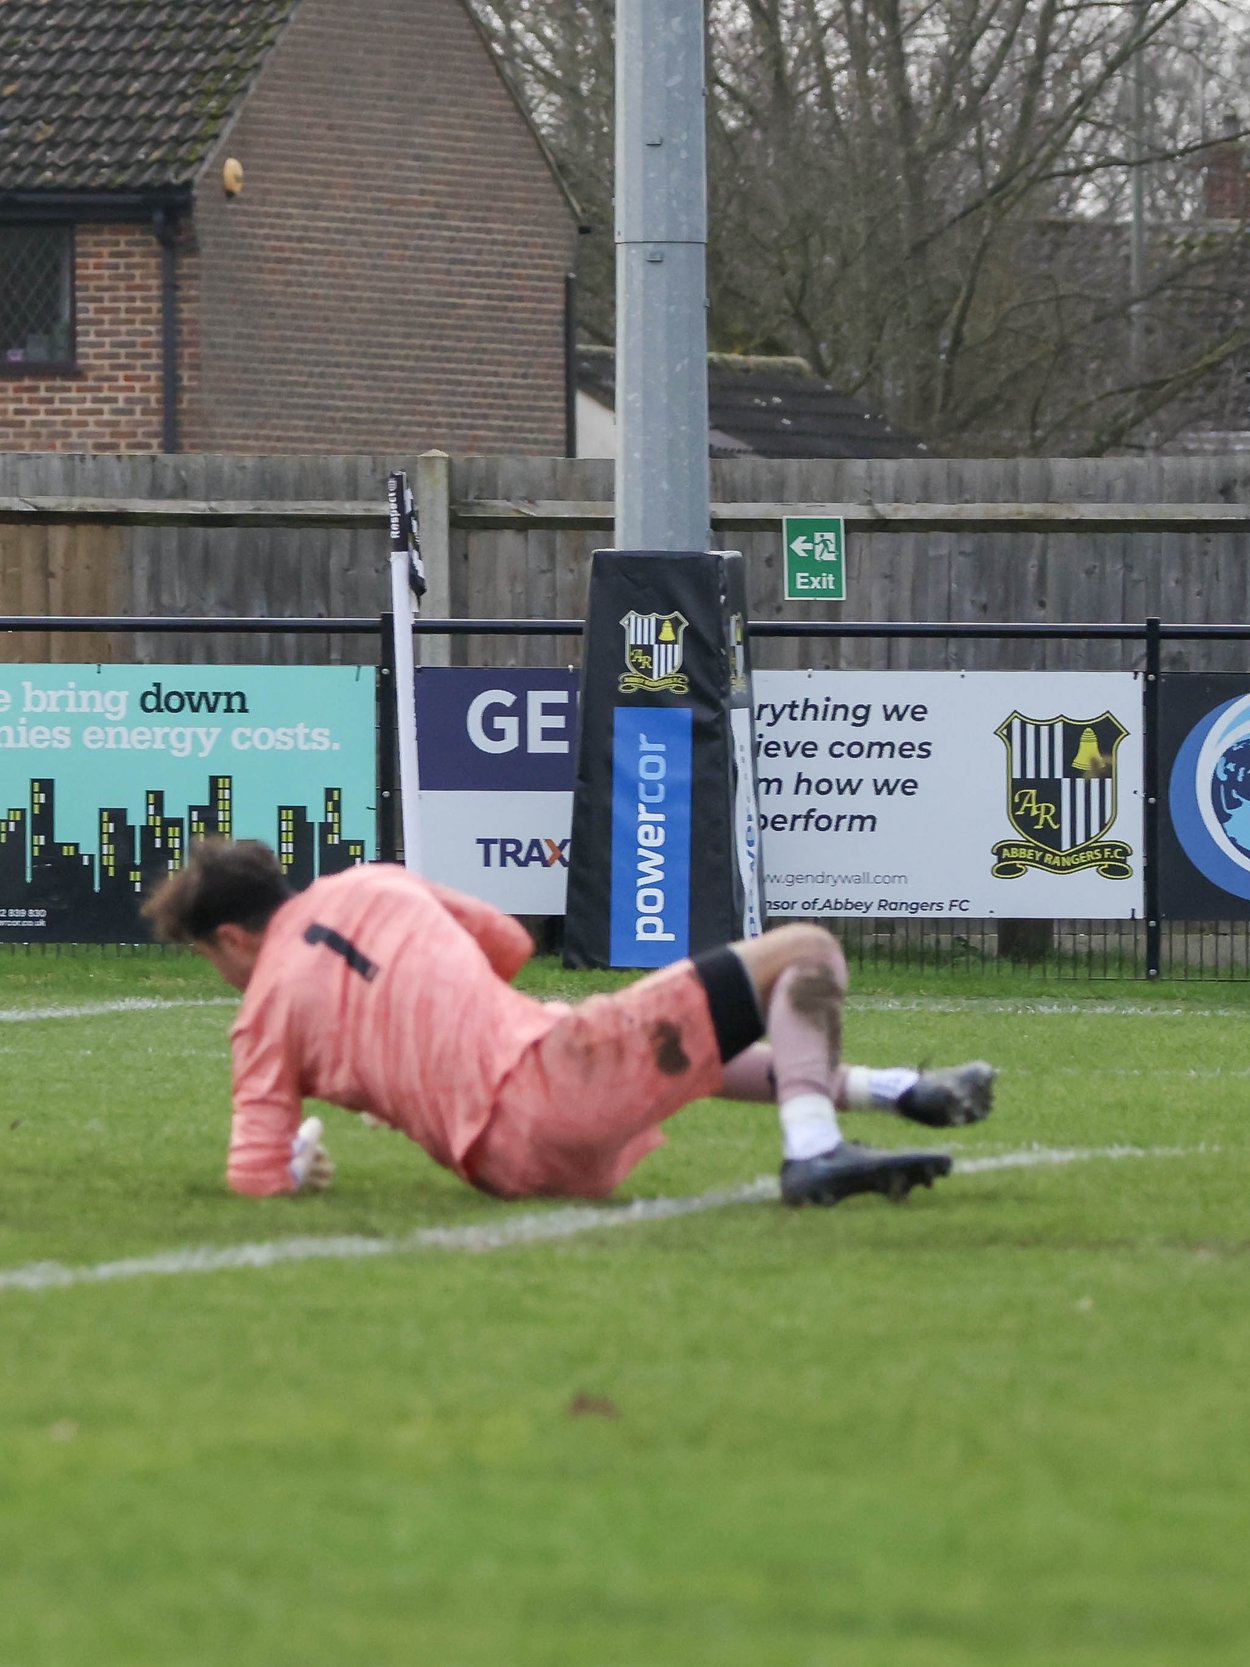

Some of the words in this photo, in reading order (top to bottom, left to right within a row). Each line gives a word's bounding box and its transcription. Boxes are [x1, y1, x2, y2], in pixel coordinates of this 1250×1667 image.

[795, 572, 836, 590] Exit
[22, 681, 129, 721] bring
[140, 682, 249, 714] down
[755, 697, 872, 727] rything
[883, 703, 928, 722] we
[467, 690, 581, 754] GE
[83, 727, 222, 757] energy
[231, 722, 341, 751] costs.
[828, 740, 932, 759] comes
[793, 772, 863, 796] how
[872, 778, 919, 796] we
[635, 733, 675, 942] powercor
[476, 838, 572, 868] TRAX
[1002, 848, 1042, 861] ABBEY
[1043, 850, 1102, 867] RANGERS
[801, 898, 818, 911] of
[823, 898, 873, 914] Abbey
[877, 899, 944, 914] Rangers
[949, 900, 970, 912] FC
[304, 923, 379, 983] 1
